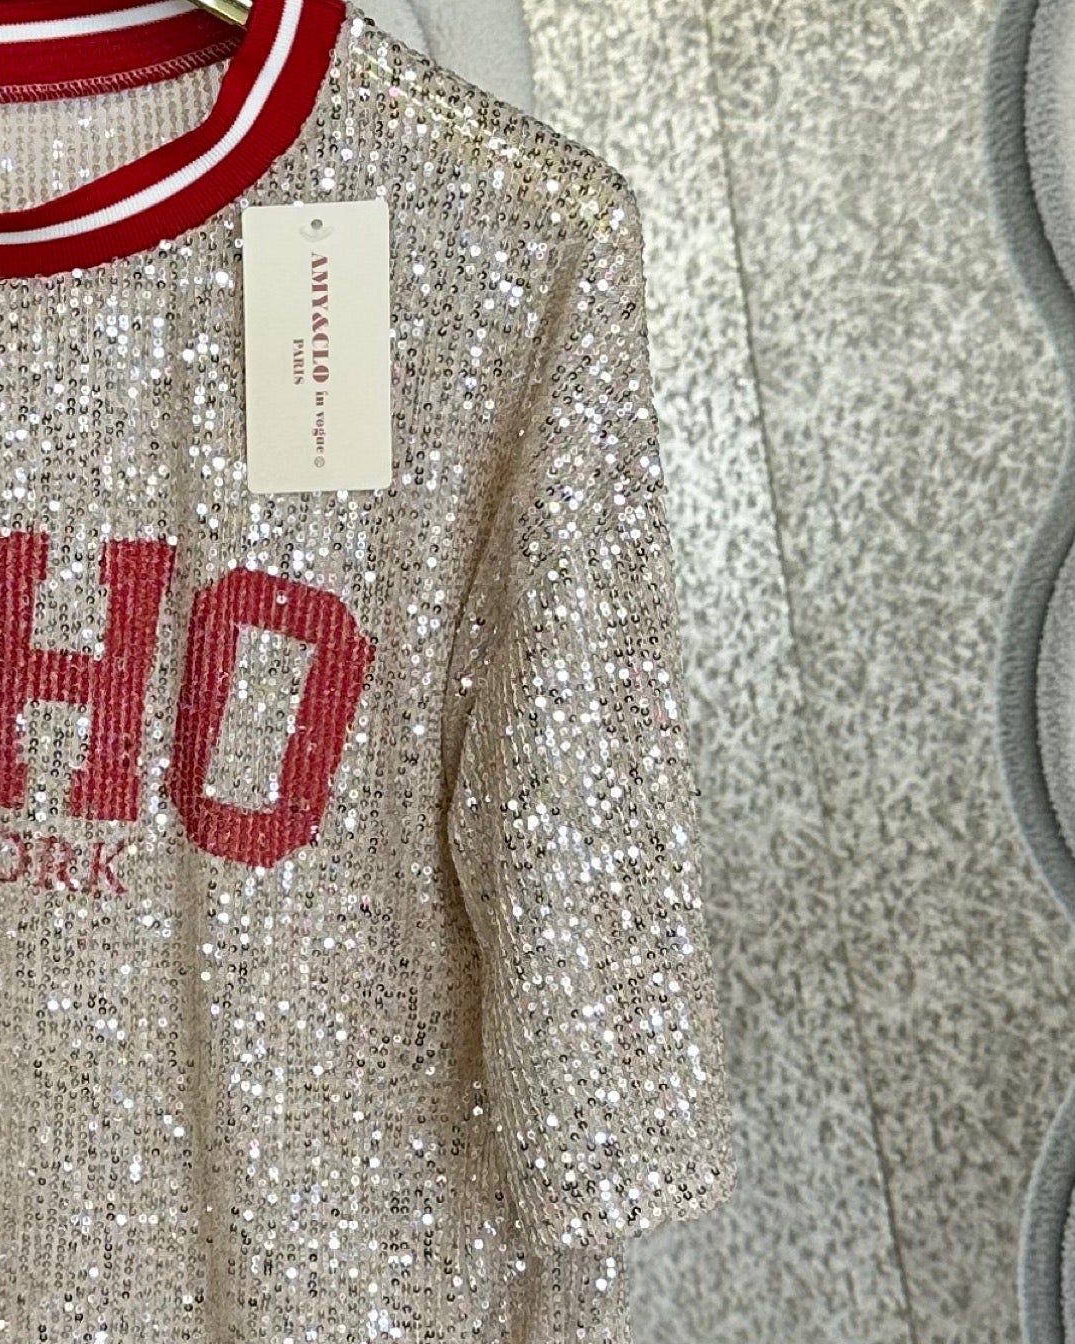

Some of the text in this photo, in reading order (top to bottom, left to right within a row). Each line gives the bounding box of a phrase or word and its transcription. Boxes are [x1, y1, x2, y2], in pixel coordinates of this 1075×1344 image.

[292, 339, 305, 385] PARIS
[311, 252, 330, 453] AMY&CLO in vogue
